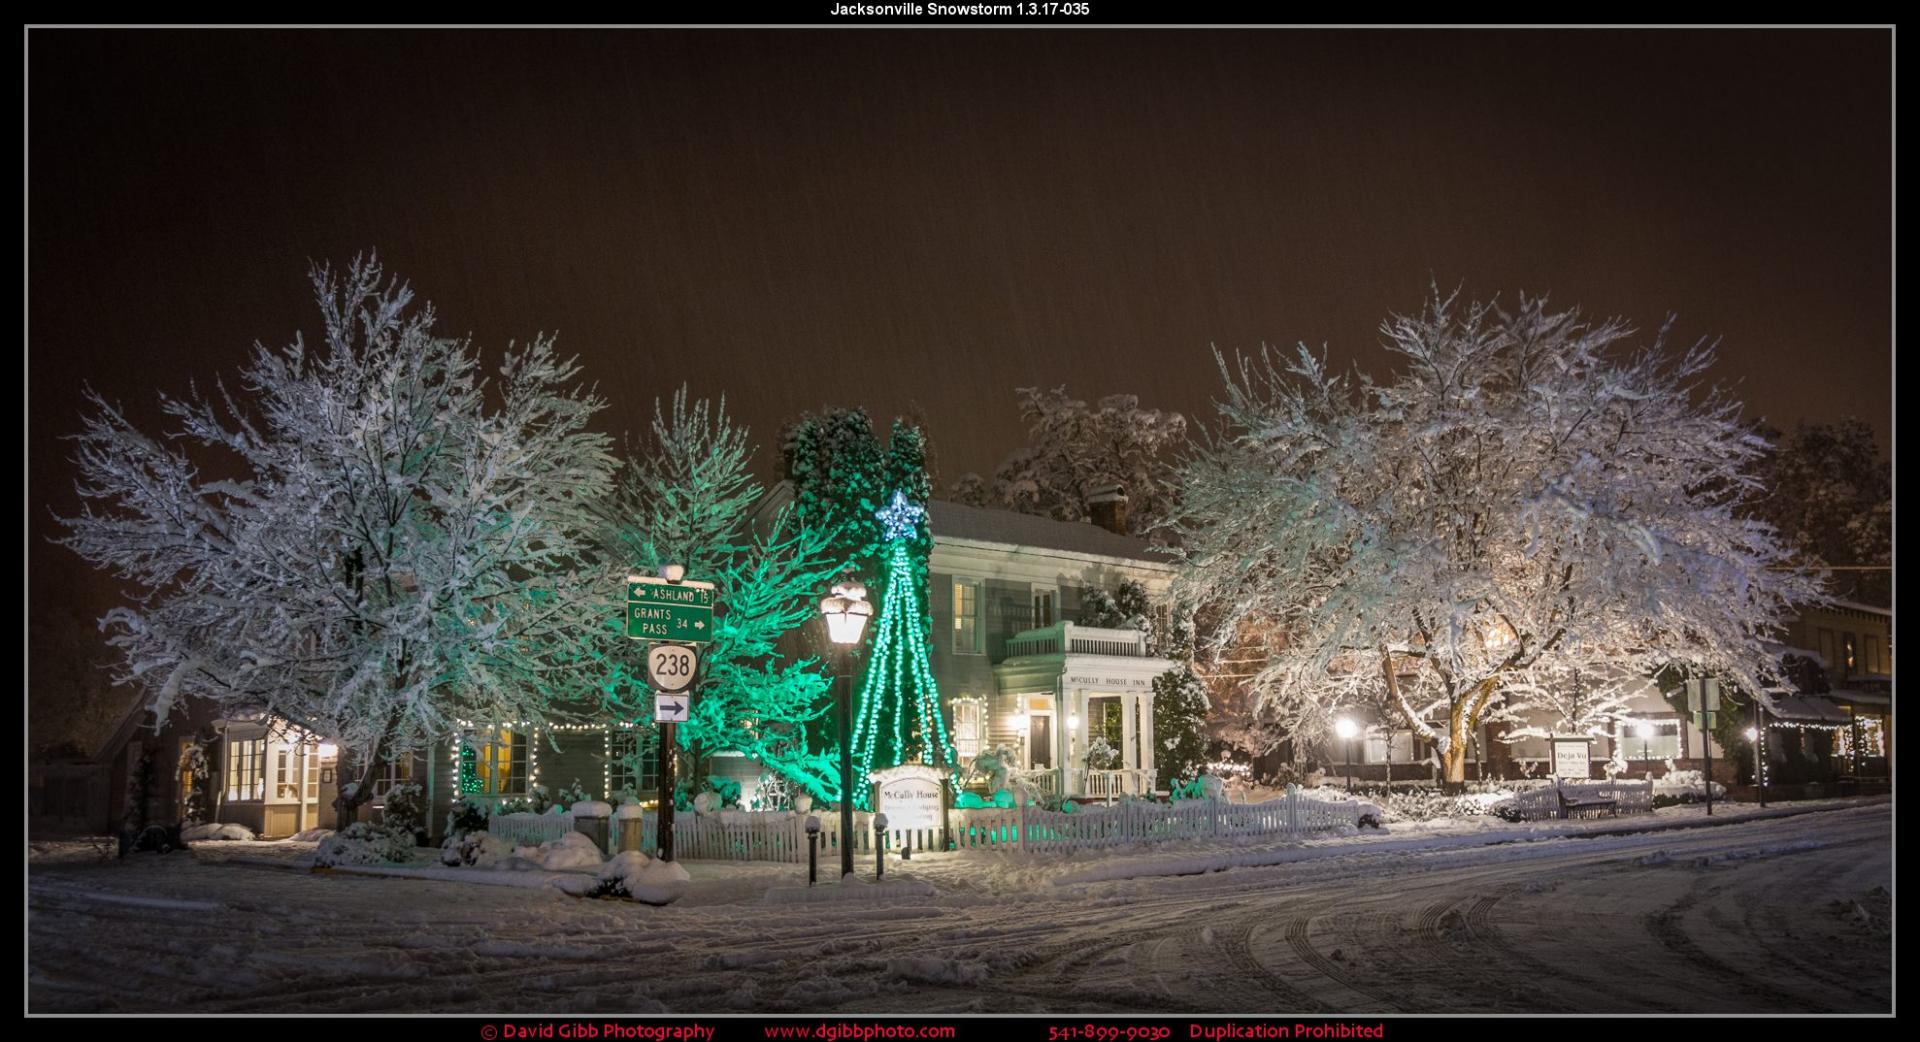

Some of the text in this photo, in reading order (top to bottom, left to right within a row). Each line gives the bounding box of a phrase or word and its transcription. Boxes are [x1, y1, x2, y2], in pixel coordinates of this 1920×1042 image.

[653, 589, 695, 602] ASHLAND
[634, 608, 672, 620] GRANTS
[642, 623, 668, 635] PASS
[676, 618, 688, 629] 34
[656, 653, 690, 676] 238
[916, 790, 939, 799] House
